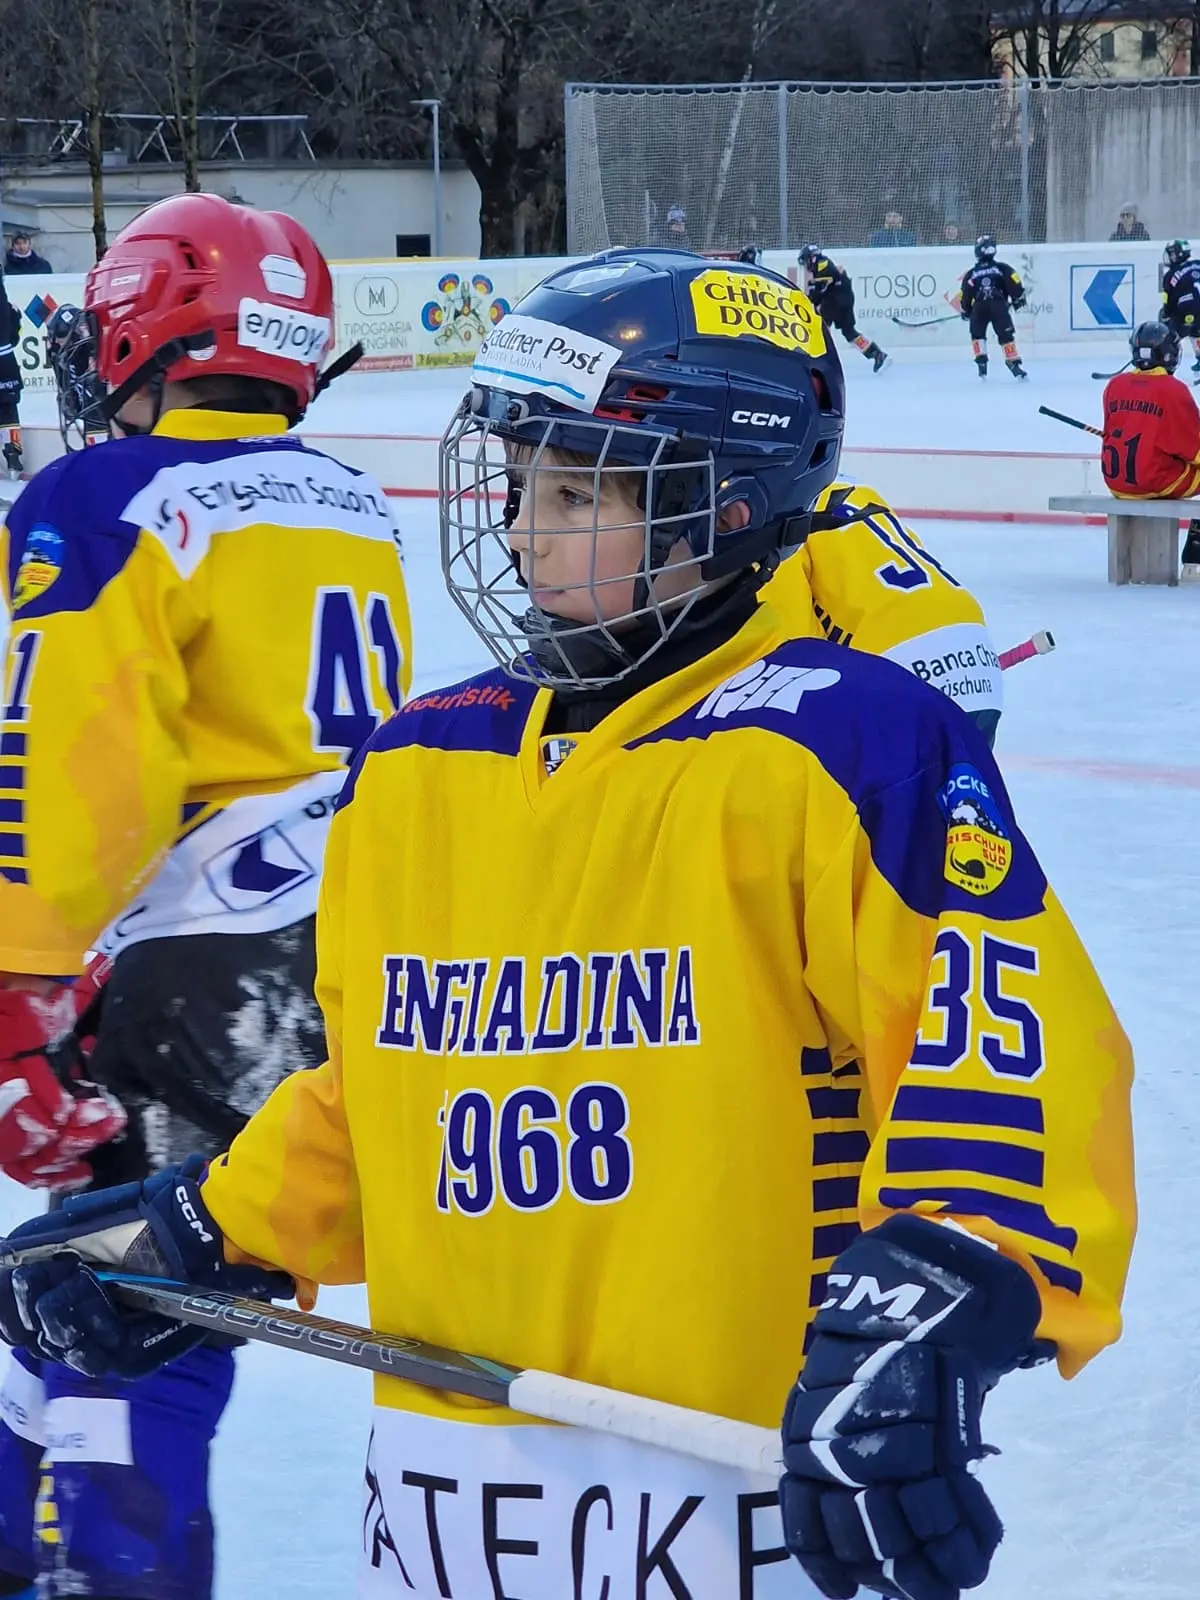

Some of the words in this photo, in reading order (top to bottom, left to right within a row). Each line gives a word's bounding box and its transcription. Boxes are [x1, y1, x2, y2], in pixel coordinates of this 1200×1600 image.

[704, 283, 811, 323] CHICCO
[858, 274, 937, 299] TOSIO
[343, 322, 412, 336] TIPOGRAFIA
[720, 305, 811, 343] D'ORO
[858, 304, 937, 319] arredamenti
[543, 337, 603, 374] Post
[731, 410, 791, 428] CCM
[912, 650, 977, 681] Banca
[982, 848, 1007, 866] SUD
[375, 945, 700, 1056] ENGIADINA
[906, 926, 1047, 1083] 35
[435, 1080, 634, 1218] 1968
[175, 1185, 214, 1243] CCM
